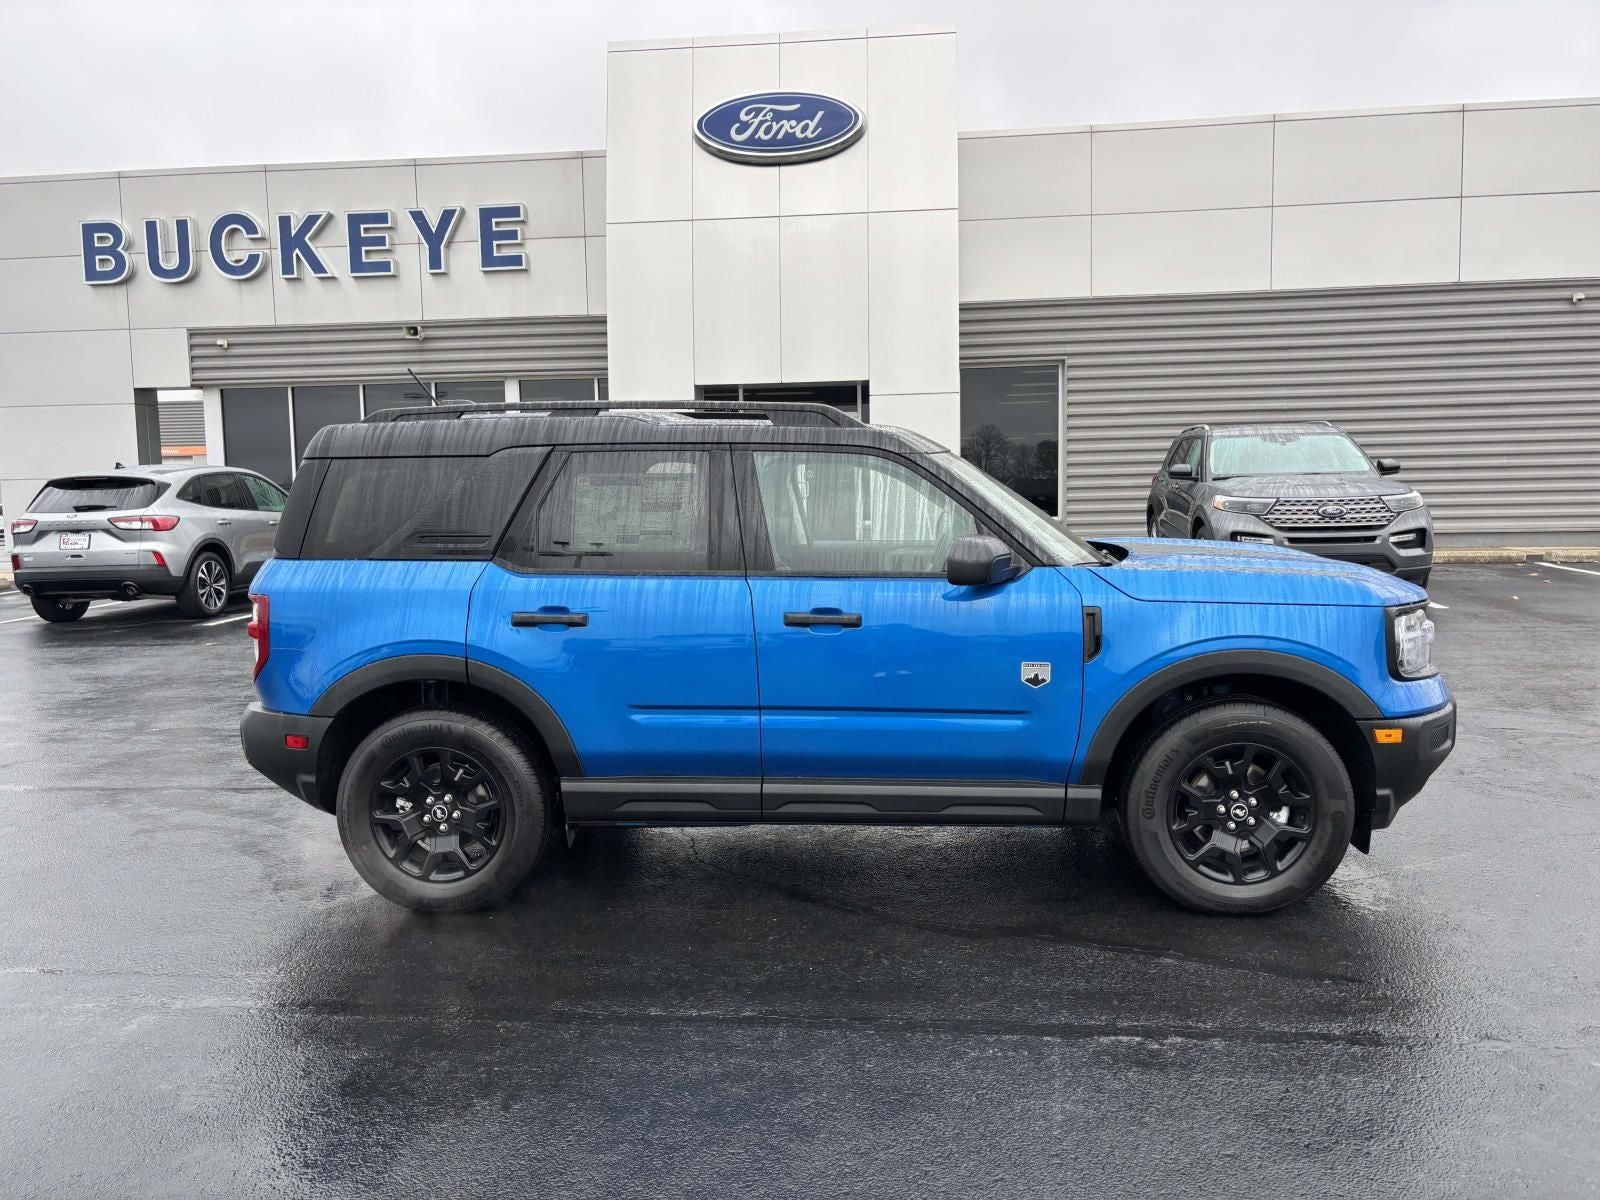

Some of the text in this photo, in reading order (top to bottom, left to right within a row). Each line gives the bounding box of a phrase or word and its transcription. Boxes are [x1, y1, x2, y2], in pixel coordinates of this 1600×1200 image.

[730, 103, 825, 142] Ford
[80, 203, 526, 285] BUCKEYE
[1141, 753, 1174, 821] Continental
